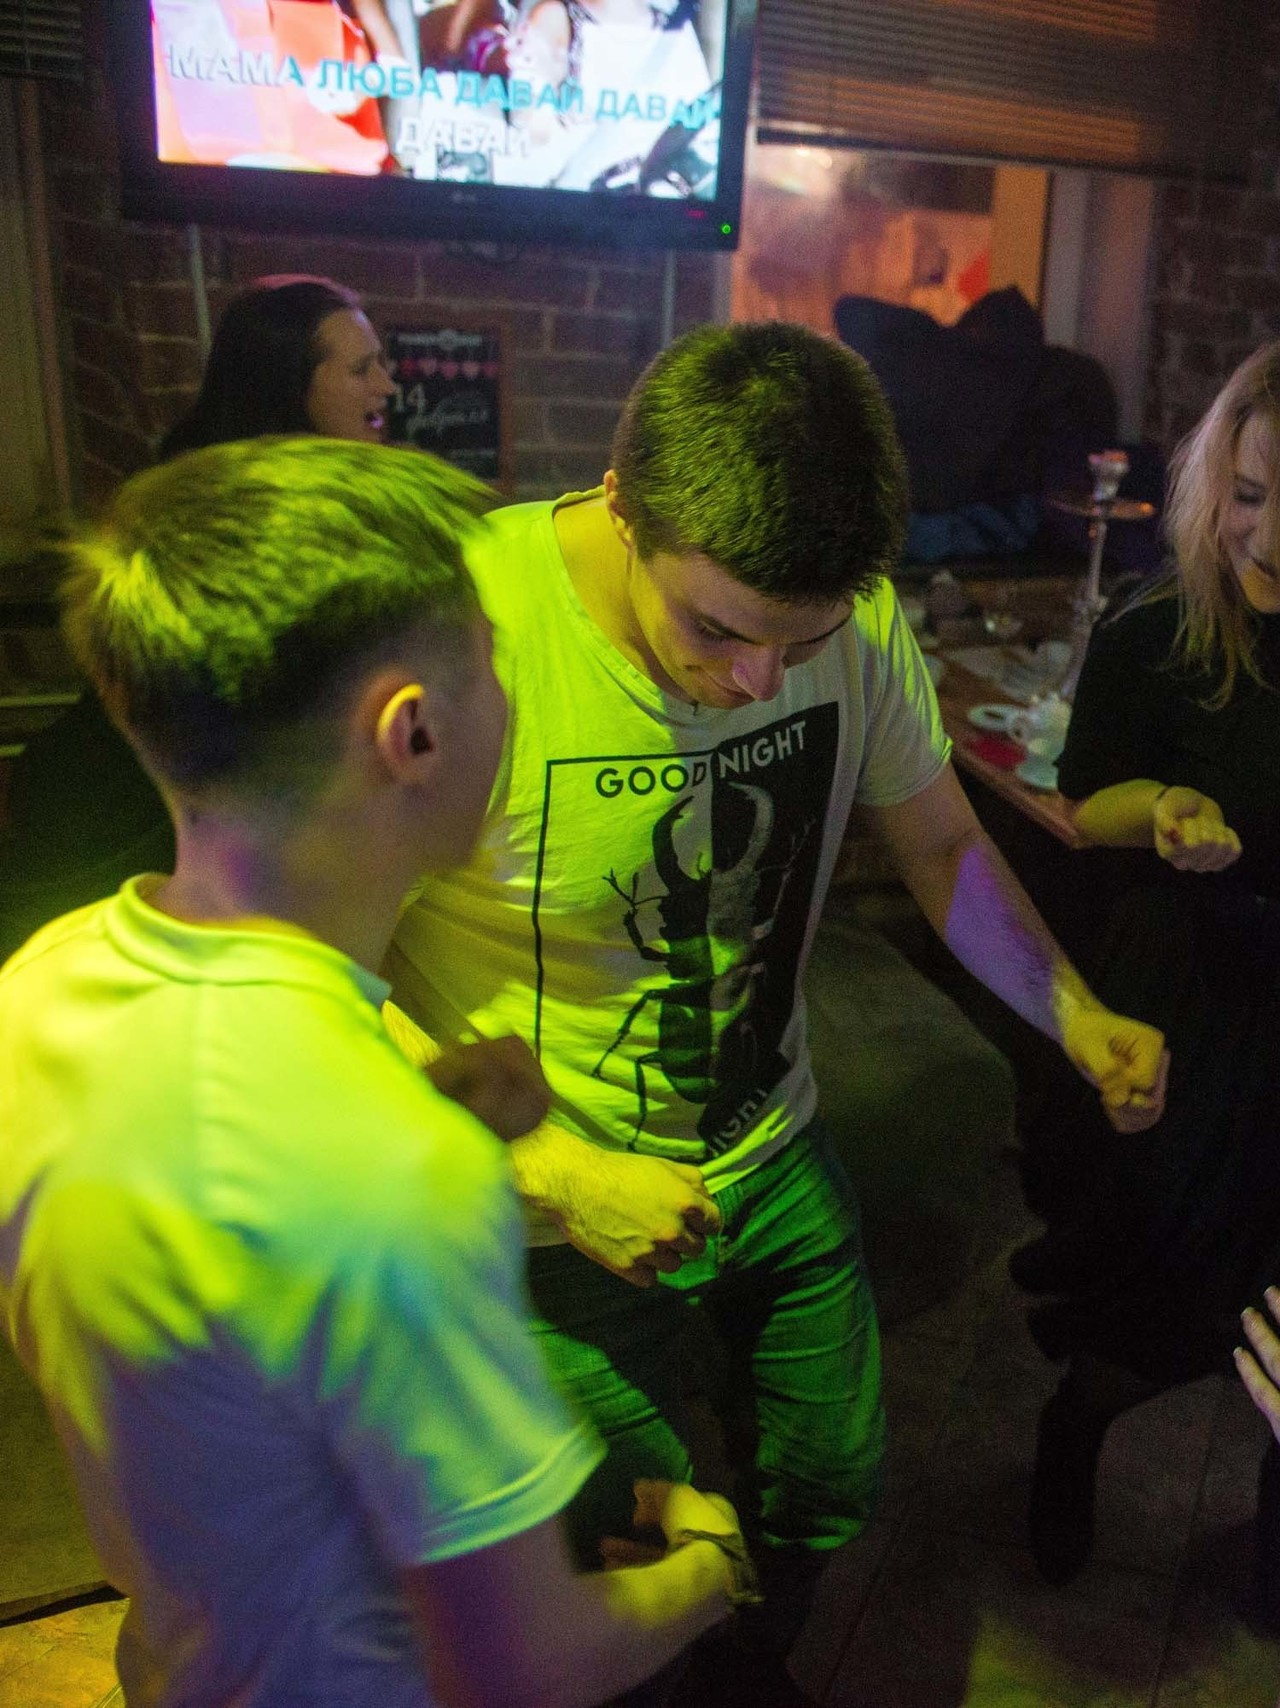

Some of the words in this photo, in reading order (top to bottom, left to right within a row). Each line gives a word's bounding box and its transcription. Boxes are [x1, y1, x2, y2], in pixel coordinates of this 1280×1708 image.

[169, 43, 305, 87] МАМА
[317, 58, 442, 99] ЛЮБА
[455, 70, 584, 114] ДАВАЙ
[595, 761, 707, 798] GOOD
[718, 720, 806, 779] NIGHT
